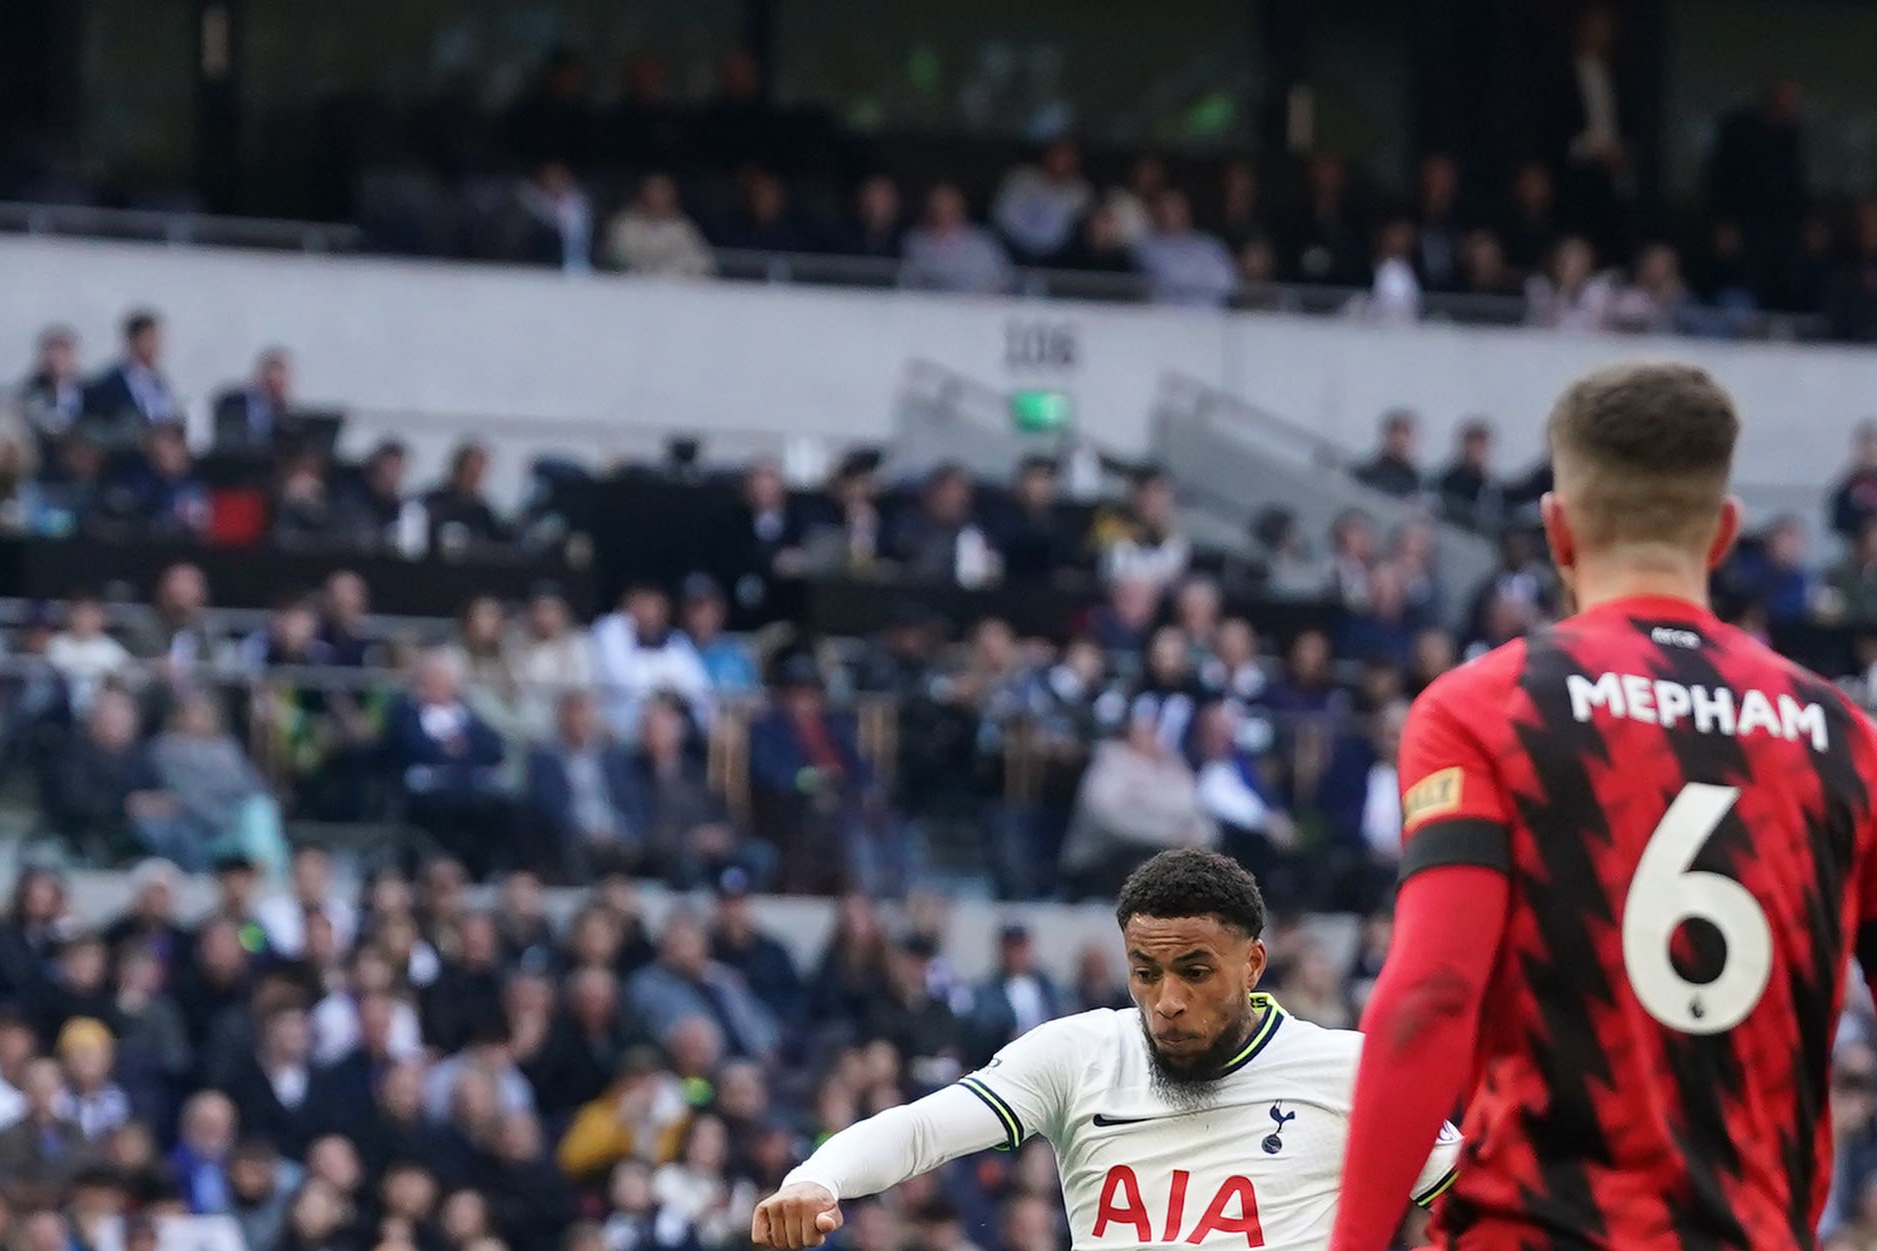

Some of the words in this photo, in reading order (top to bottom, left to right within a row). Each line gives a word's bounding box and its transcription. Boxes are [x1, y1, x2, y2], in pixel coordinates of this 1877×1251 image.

[1565, 672, 1829, 753] MEPHAM
[1621, 781, 1774, 1036] 6
[1092, 1164, 1265, 1249] AIA
